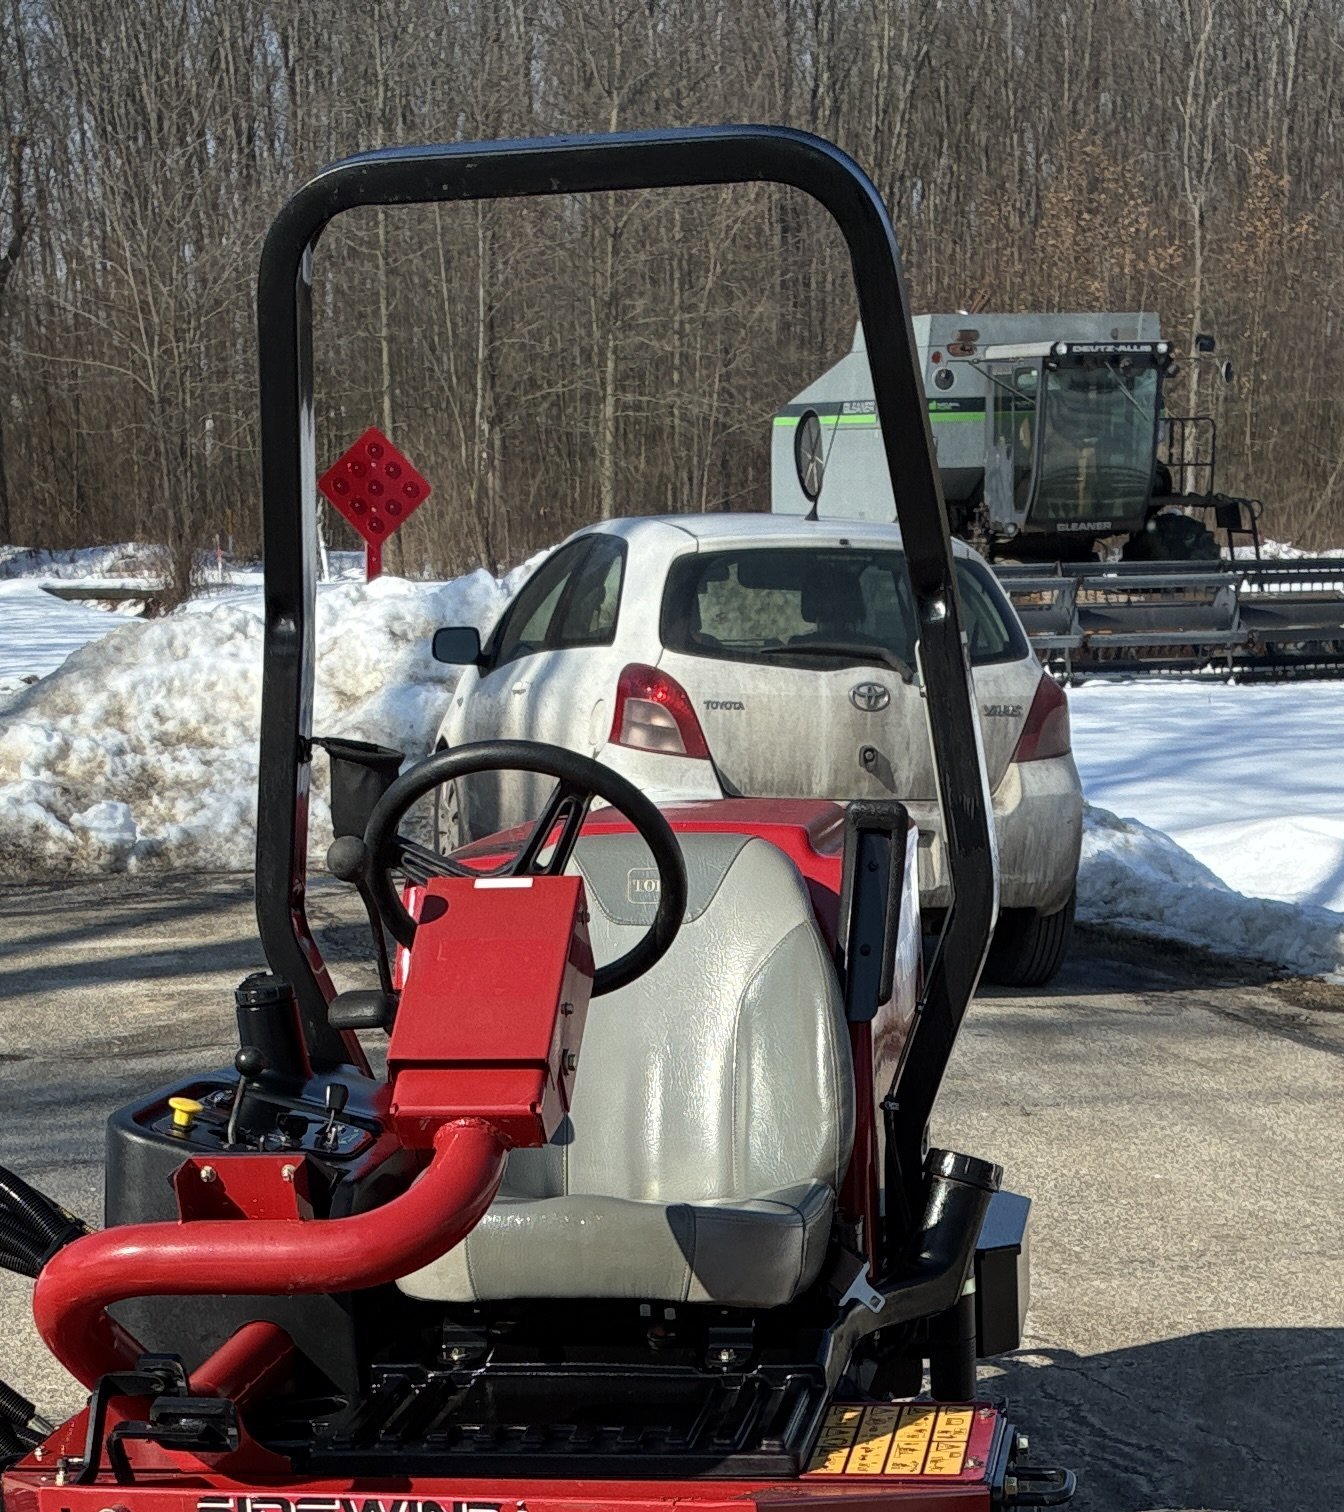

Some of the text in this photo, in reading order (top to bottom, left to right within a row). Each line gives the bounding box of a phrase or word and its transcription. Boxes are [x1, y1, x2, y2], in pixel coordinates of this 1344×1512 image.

[1072, 345, 1152, 353] DEUTZ-ALLIS
[1056, 521, 1112, 531] GLEANER
[703, 700, 745, 711] TOYOTA
[632, 879, 661, 892] TO
